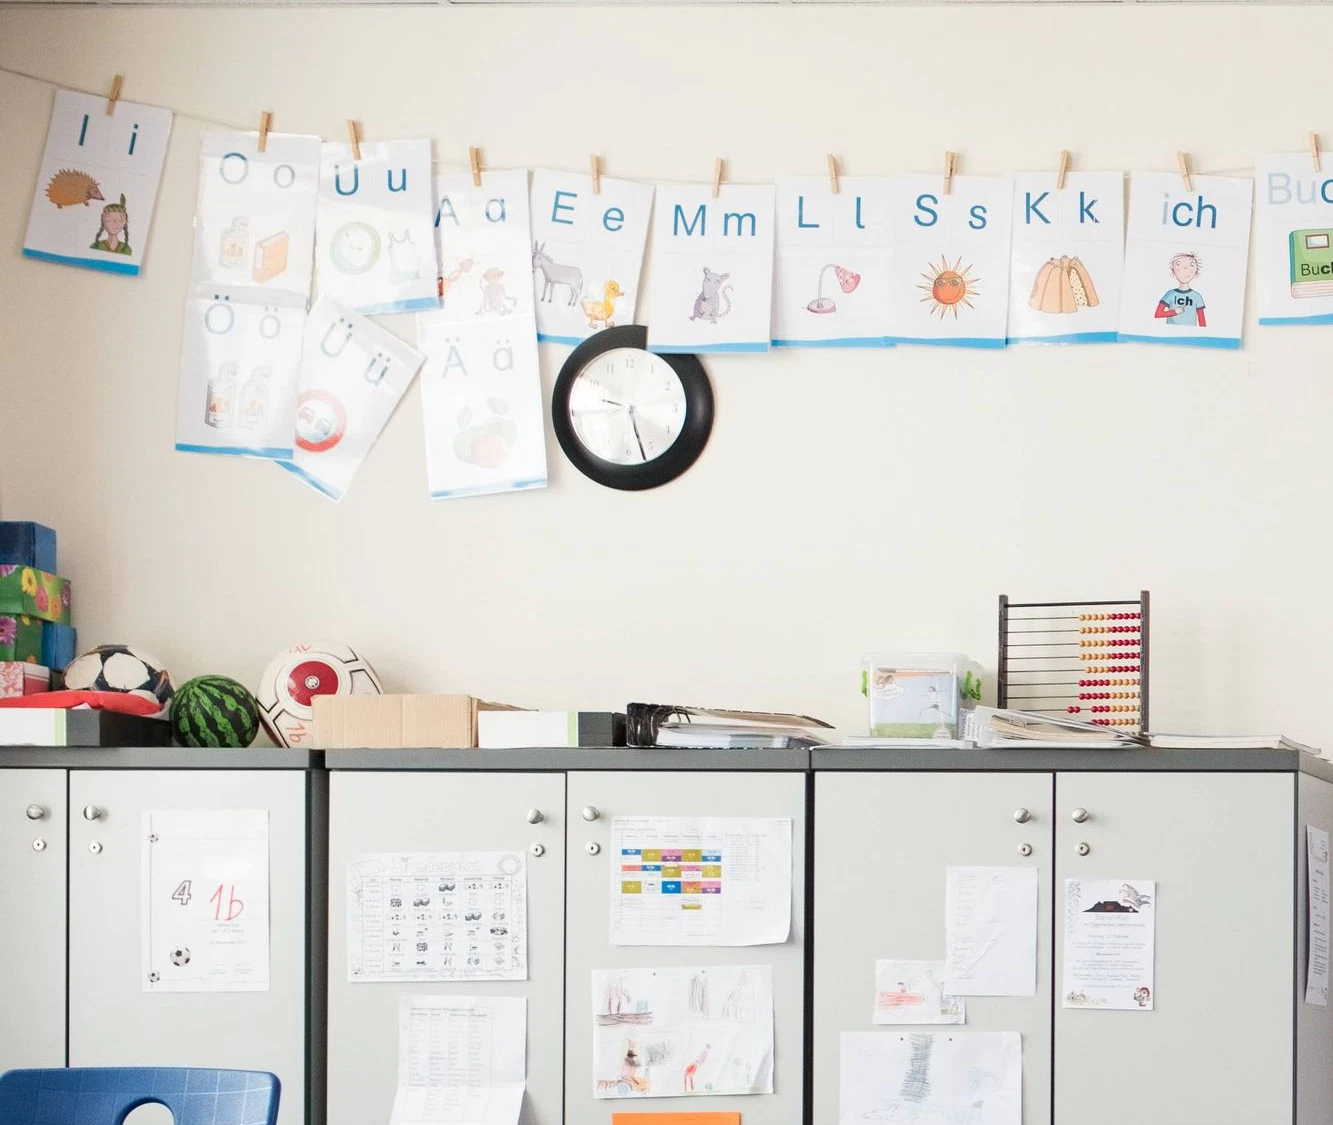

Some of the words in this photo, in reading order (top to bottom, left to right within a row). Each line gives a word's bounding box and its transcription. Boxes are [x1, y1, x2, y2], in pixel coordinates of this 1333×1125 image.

[79, 114, 89, 146] I
[128, 124, 138, 155] i
[218, 151, 249, 185] O
[272, 163, 296, 188] o
[335, 159, 360, 196] U
[388, 169, 406, 192] u
[434, 193, 461, 228] A
[485, 199, 505, 222] a
[552, 191, 577, 225] E
[603, 208, 624, 231] e
[674, 205, 706, 236] M
[724, 213, 756, 236] m
[798, 196, 819, 228] L
[856, 197, 865, 229] l
[914, 194, 938, 227] S
[969, 205, 987, 229] s
[1026, 192, 1051, 224] K
[1080, 192, 1101, 223] k
[1161, 196, 1216, 228] ich
[172, 880, 192, 905] 4
[209, 884, 244, 921] 1b
